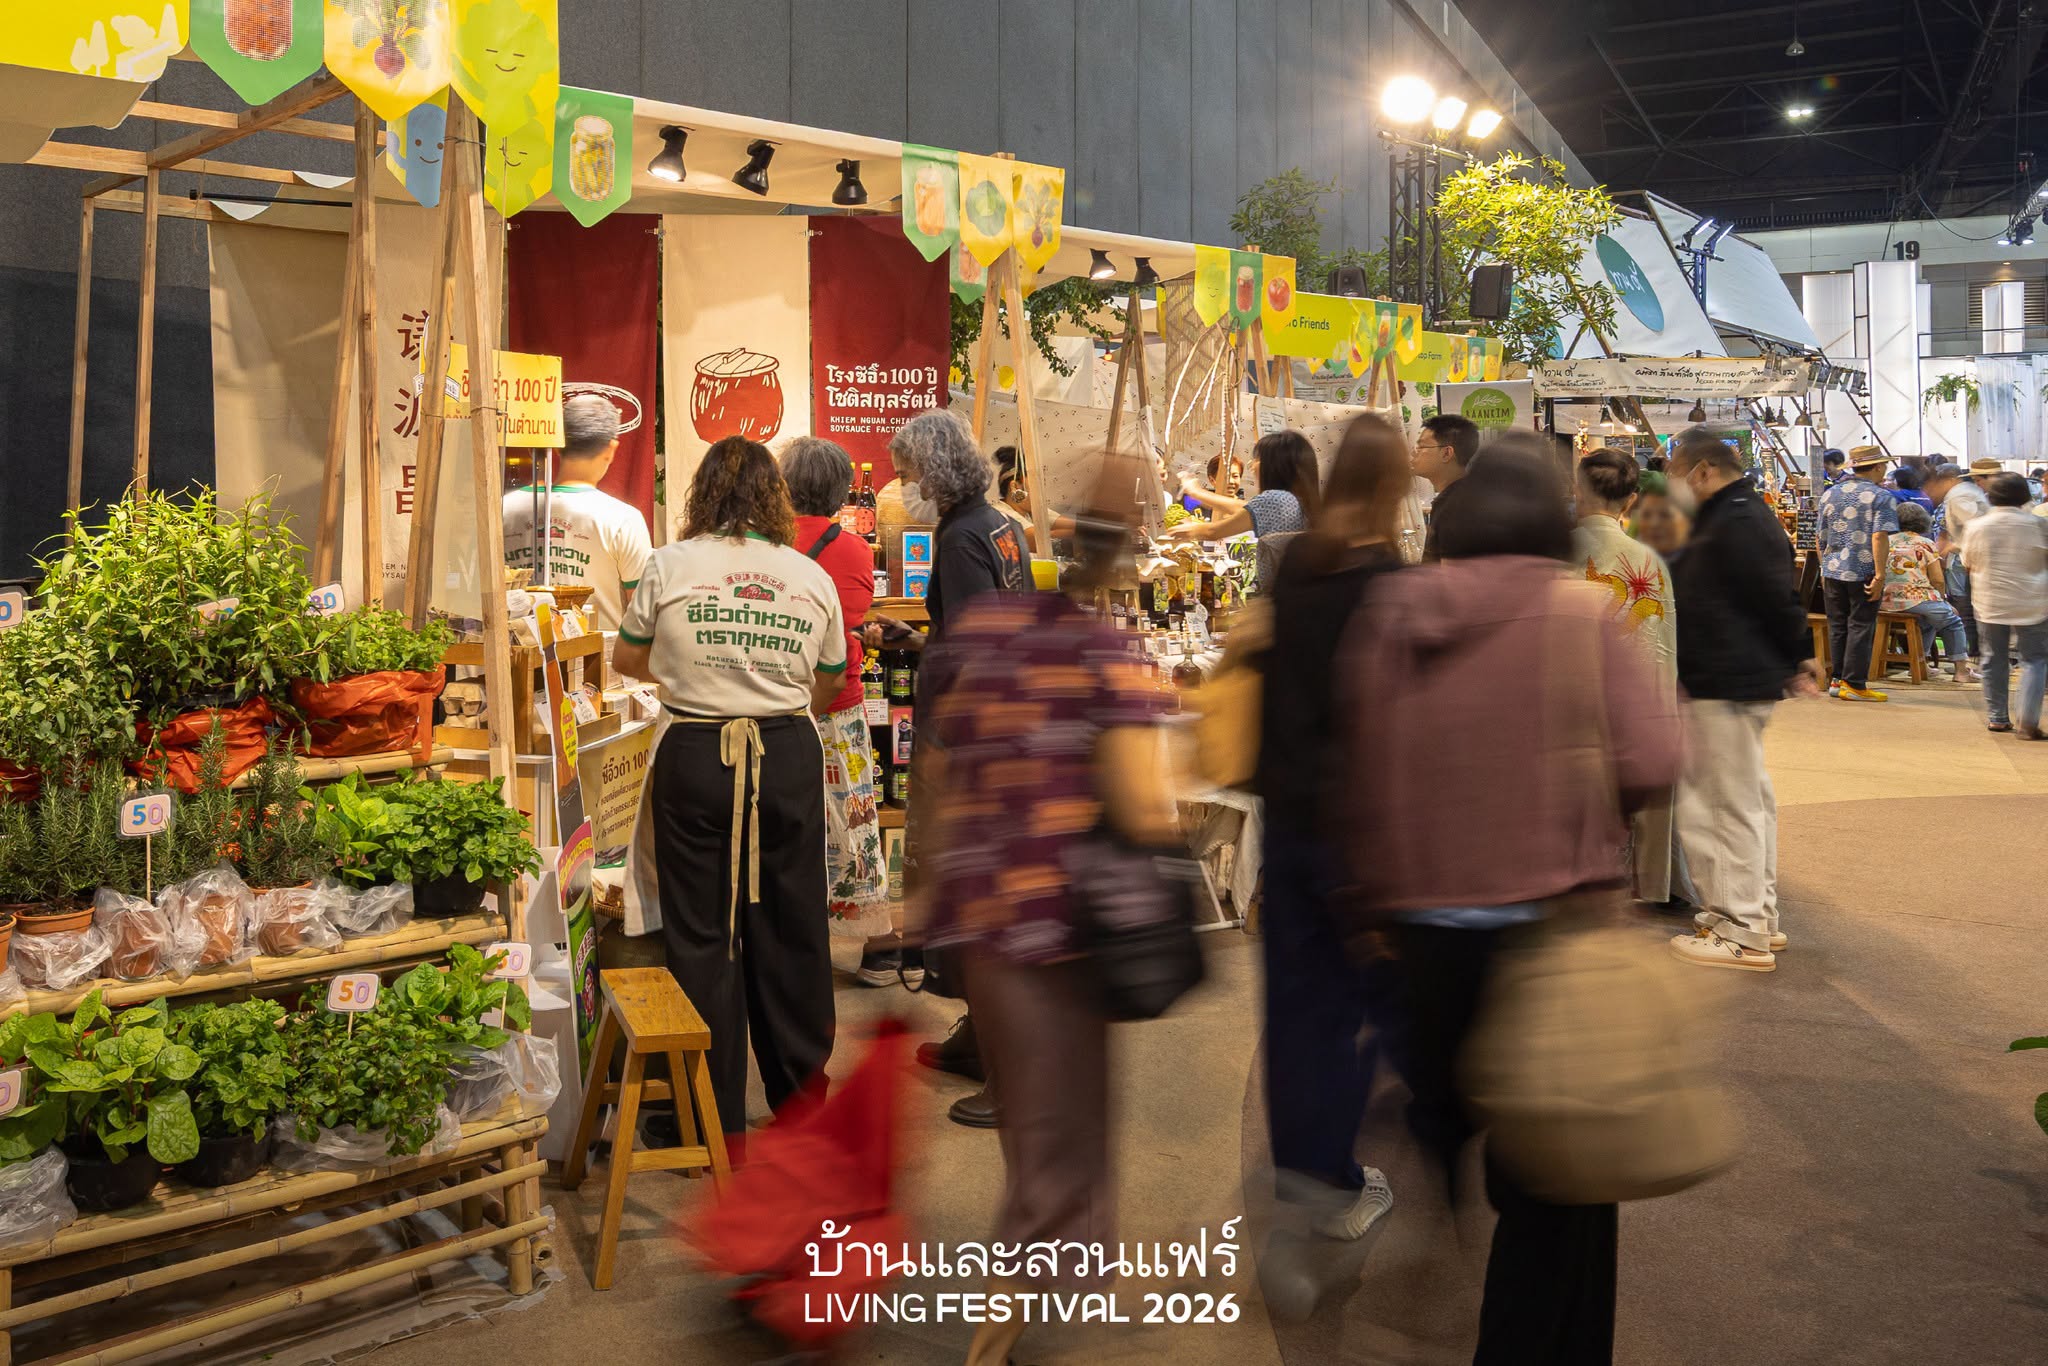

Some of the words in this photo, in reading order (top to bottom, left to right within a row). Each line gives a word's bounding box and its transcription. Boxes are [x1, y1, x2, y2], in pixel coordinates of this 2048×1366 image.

[1893, 240, 1920, 260] 19
[1300, 316, 1330, 331] Friends
[890, 368, 923, 385] 100
[924, 366, 938, 385] ปี
[514, 377, 541, 403] 100
[545, 376, 557, 403] ปี
[825, 385, 938, 413] โชติสกุลรัตน์
[830, 415, 856, 424] KHIEM
[860, 416, 886, 425] NGUAN
[890, 417, 915, 425] CHIA
[830, 424, 871, 433] SOYSAUCE
[876, 425, 905, 434] FACTO
[686, 595, 813, 636] ซีอิ๊วดำหวาน
[696, 629, 804, 655] ตรากุหลาบ
[706, 654, 748, 667] Naturally
[752, 660, 791, 670] Fermented
[602, 756, 631, 785] ซีอิ๊วดำ
[132, 803, 163, 825] 50
[338, 980, 370, 1003] 50
